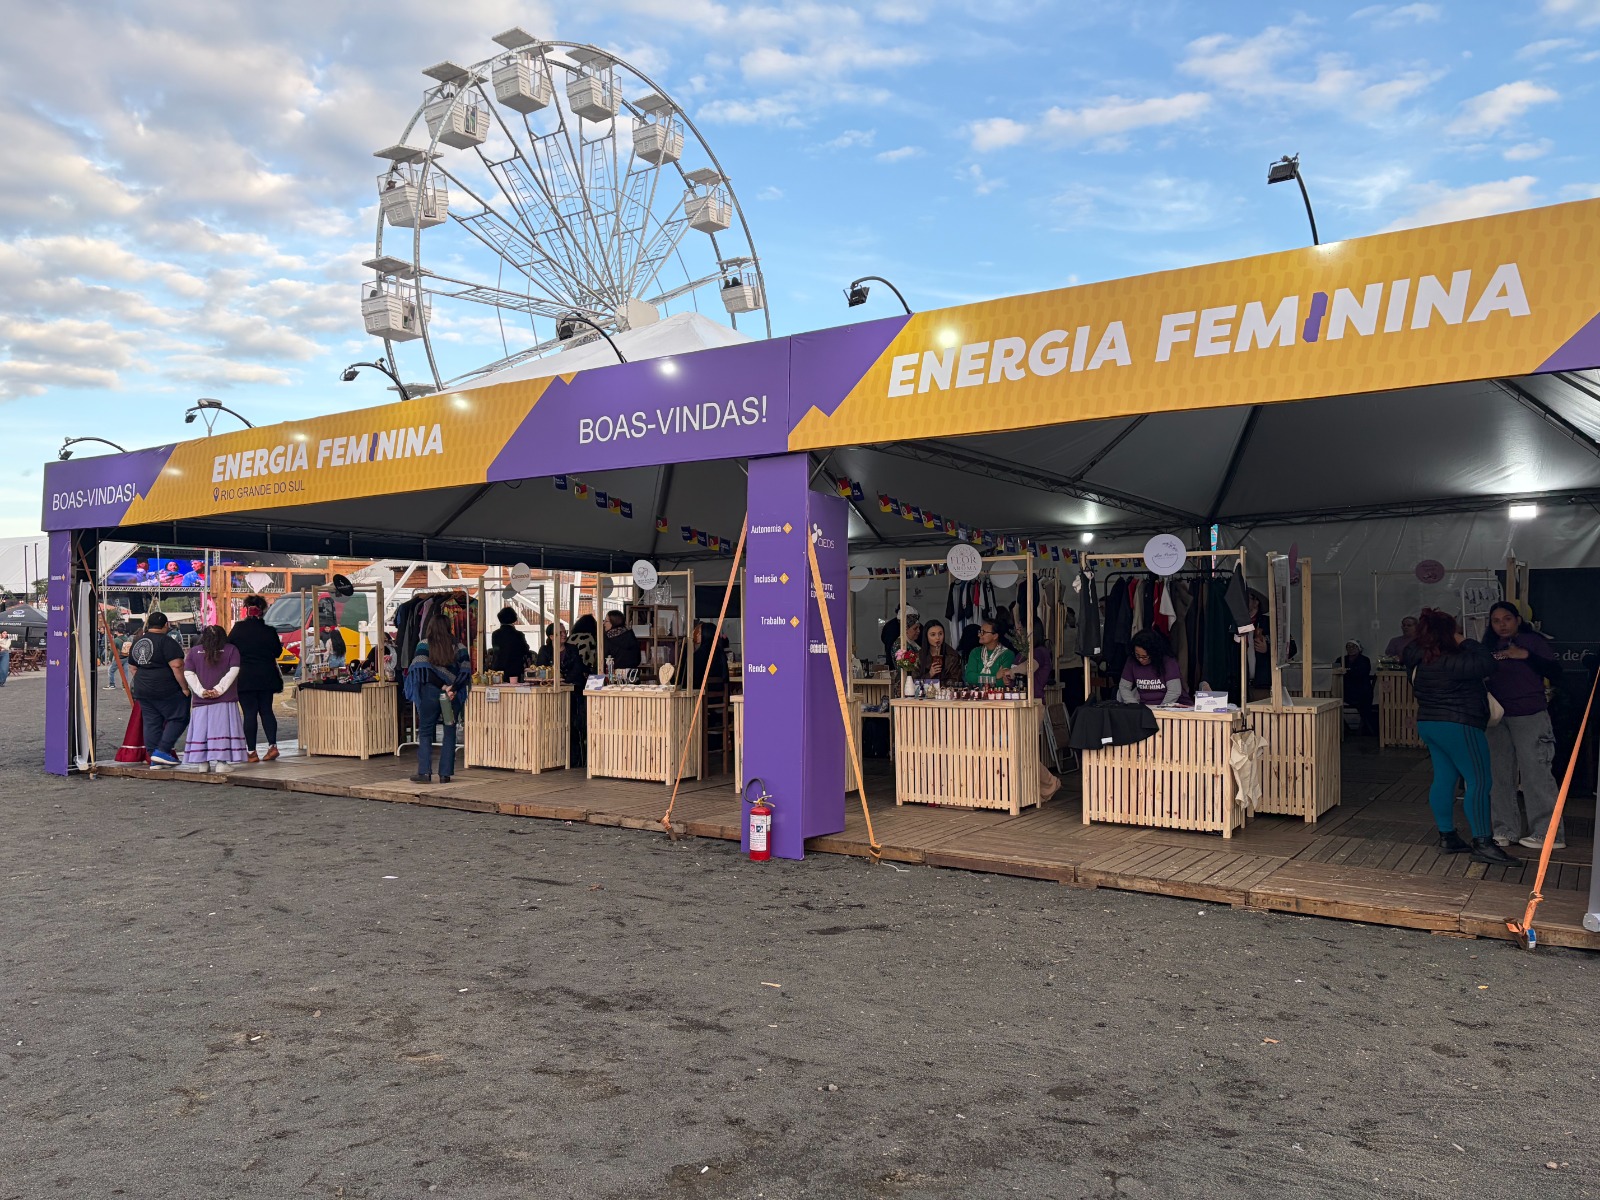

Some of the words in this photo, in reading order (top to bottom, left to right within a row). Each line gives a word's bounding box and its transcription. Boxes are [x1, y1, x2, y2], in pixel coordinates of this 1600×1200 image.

[887, 320, 1132, 398] ENERGIA
[1155, 262, 1531, 362] FEMININA
[579, 395, 767, 444] BOAS-VINDAS!
[211, 441, 309, 483] ENERGIA
[316, 423, 444, 469] FEMININA
[52, 482, 136, 511] BOAS-VINDAS!
[220, 488, 235, 501] RIO
[236, 483, 272, 499] GRANDE
[273, 481, 287, 494] DO
[288, 479, 305, 493] SUL
[750, 524, 782, 534] Autonomia
[753, 573, 778, 583] Inclusão
[760, 616, 786, 625] Trabalho
[748, 663, 767, 673] Renda
